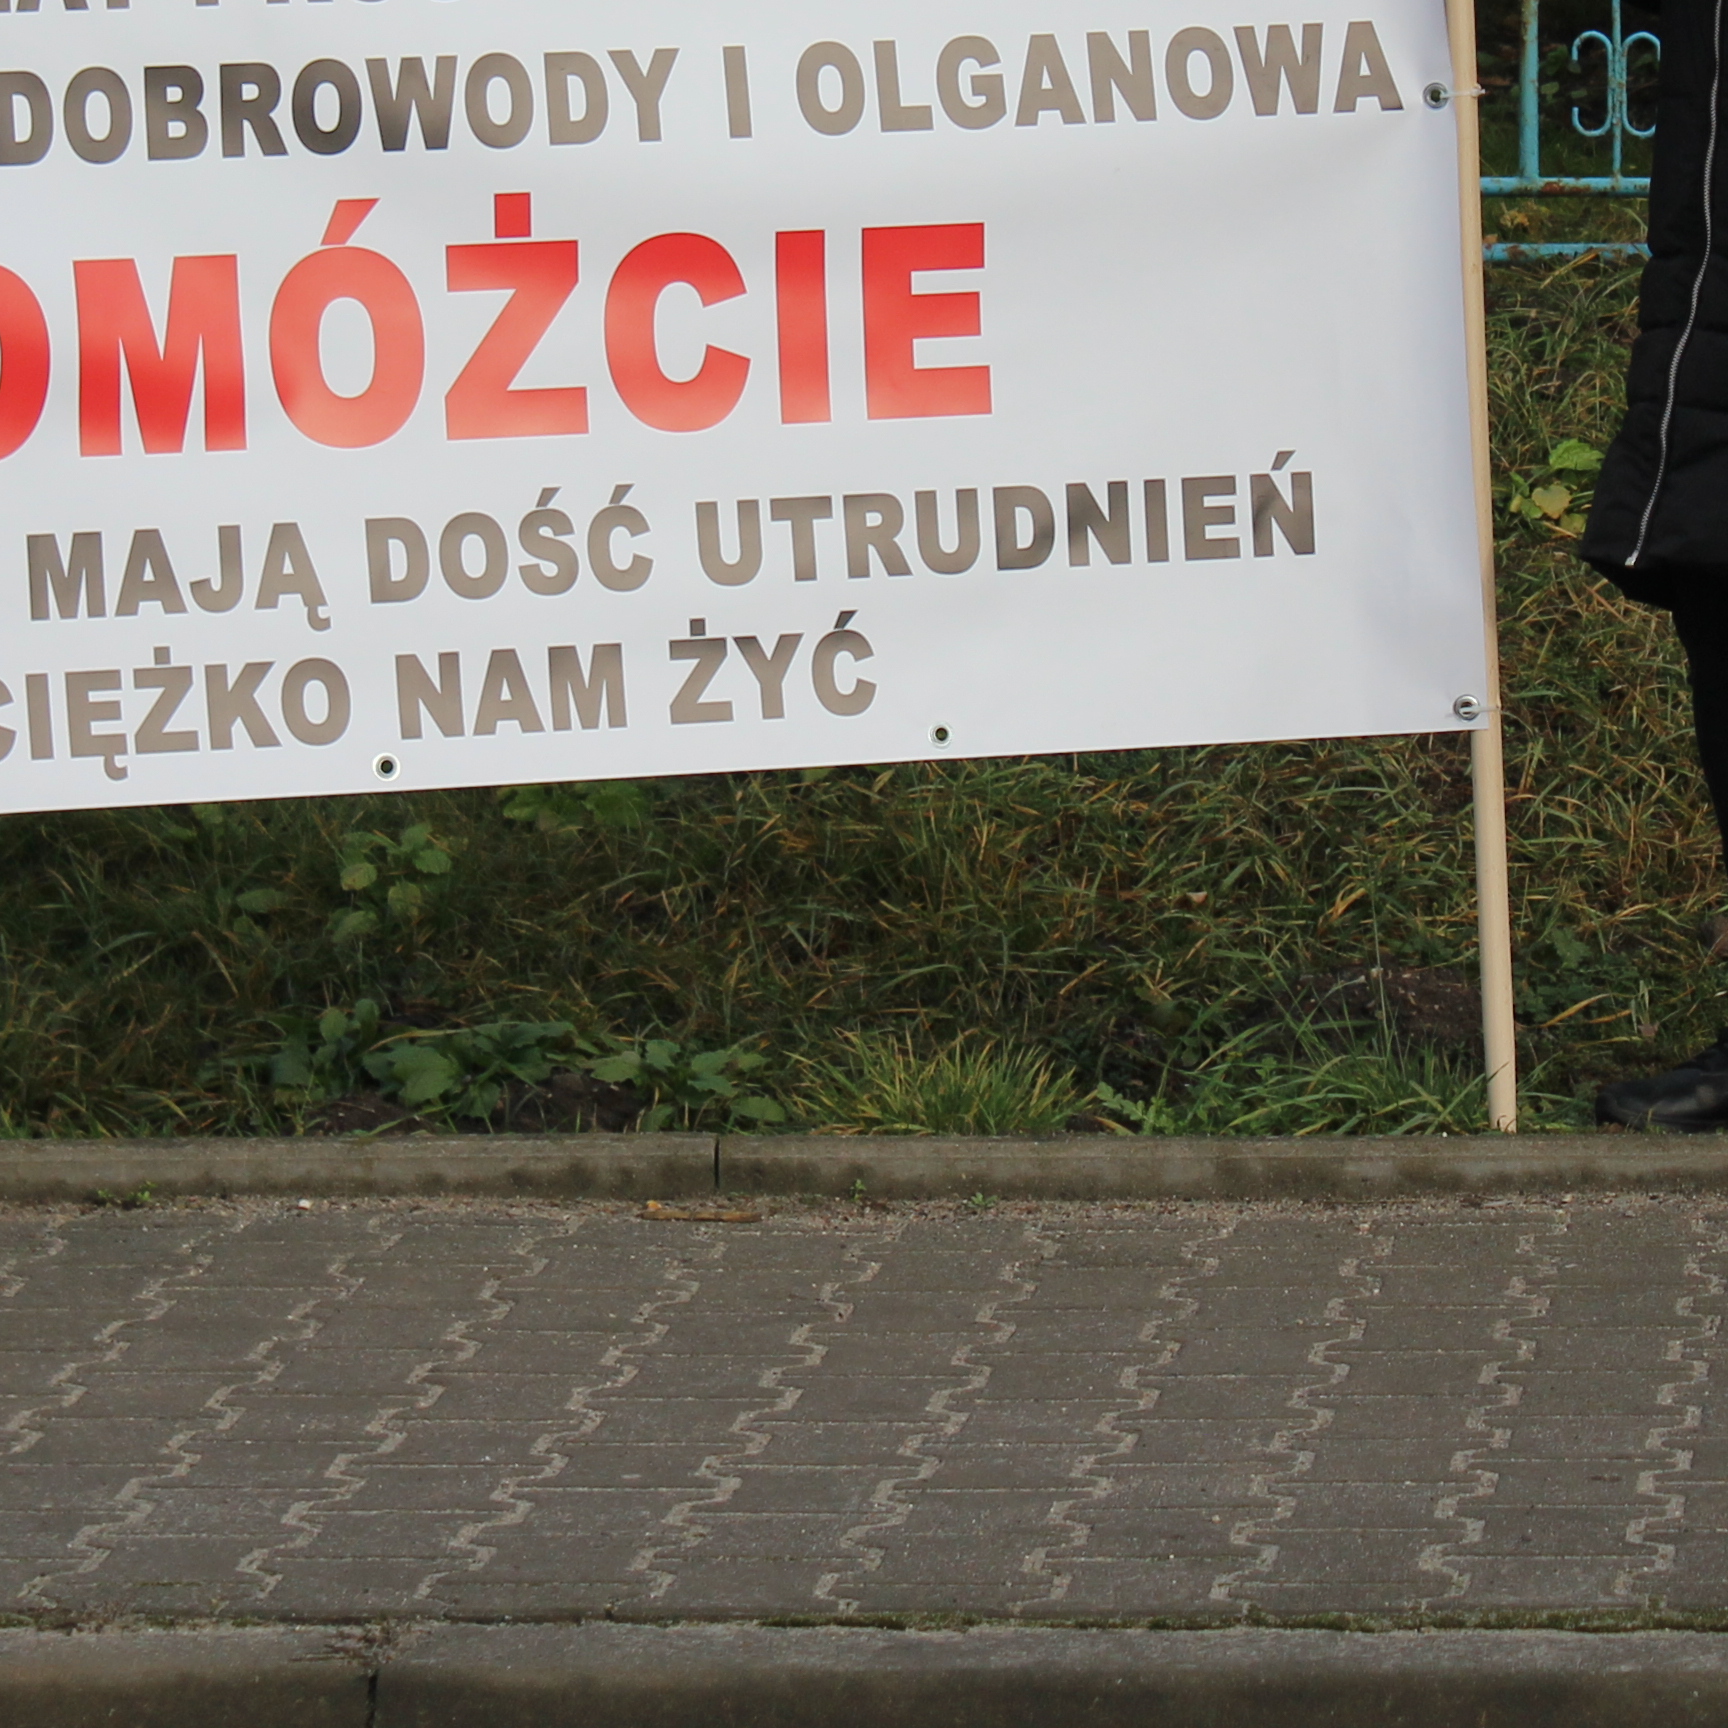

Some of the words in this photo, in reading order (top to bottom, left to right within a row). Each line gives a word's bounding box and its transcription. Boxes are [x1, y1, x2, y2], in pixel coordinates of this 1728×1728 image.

[724, 46, 751, 137] I
[797, 21, 1404, 135] OLGANOWA
[27, 523, 330, 630] MAJĄ
[365, 484, 652, 603] DOŚĆ
[696, 451, 1315, 585] UTRUDNIEŃ
[396, 643, 626, 739] NAM
[669, 610, 876, 724] ŻYĆ
